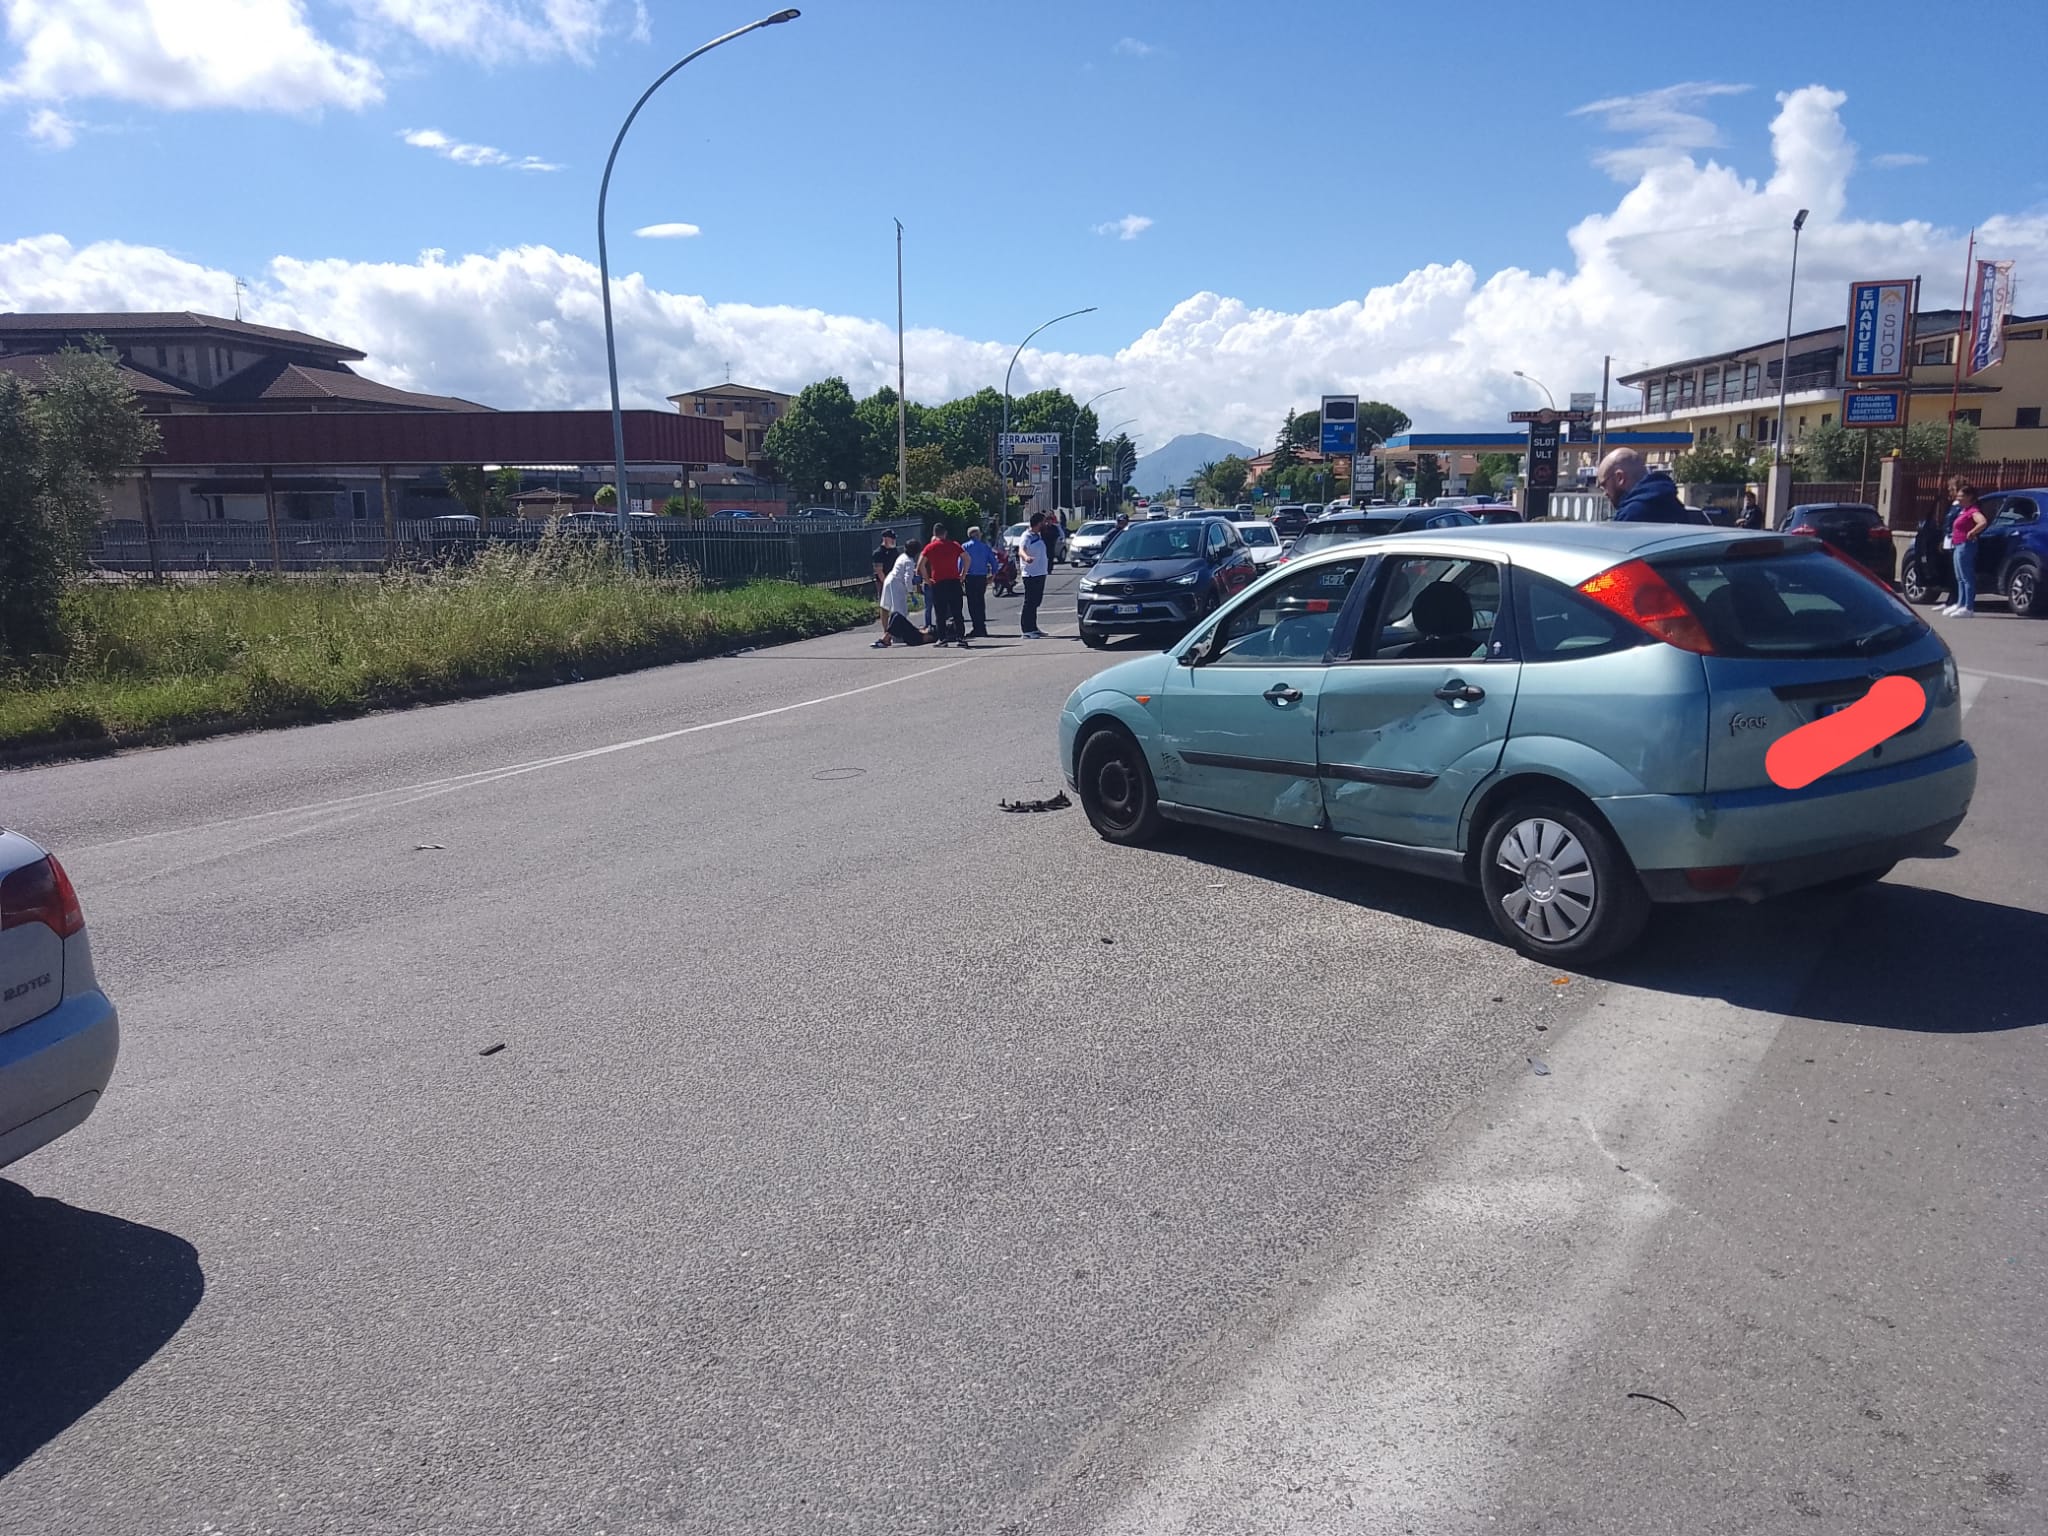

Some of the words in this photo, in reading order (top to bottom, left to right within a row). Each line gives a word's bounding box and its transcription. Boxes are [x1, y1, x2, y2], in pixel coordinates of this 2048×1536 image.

[1857, 290, 1874, 373] EMANUELE
[1880, 314, 1896, 371] SHOP
[999, 434, 1058, 444] FERRAMENTA
[1533, 438, 1555, 447] SLOT
[1535, 450, 1552, 459] VLT
[999, 460, 1030, 476] OVS
